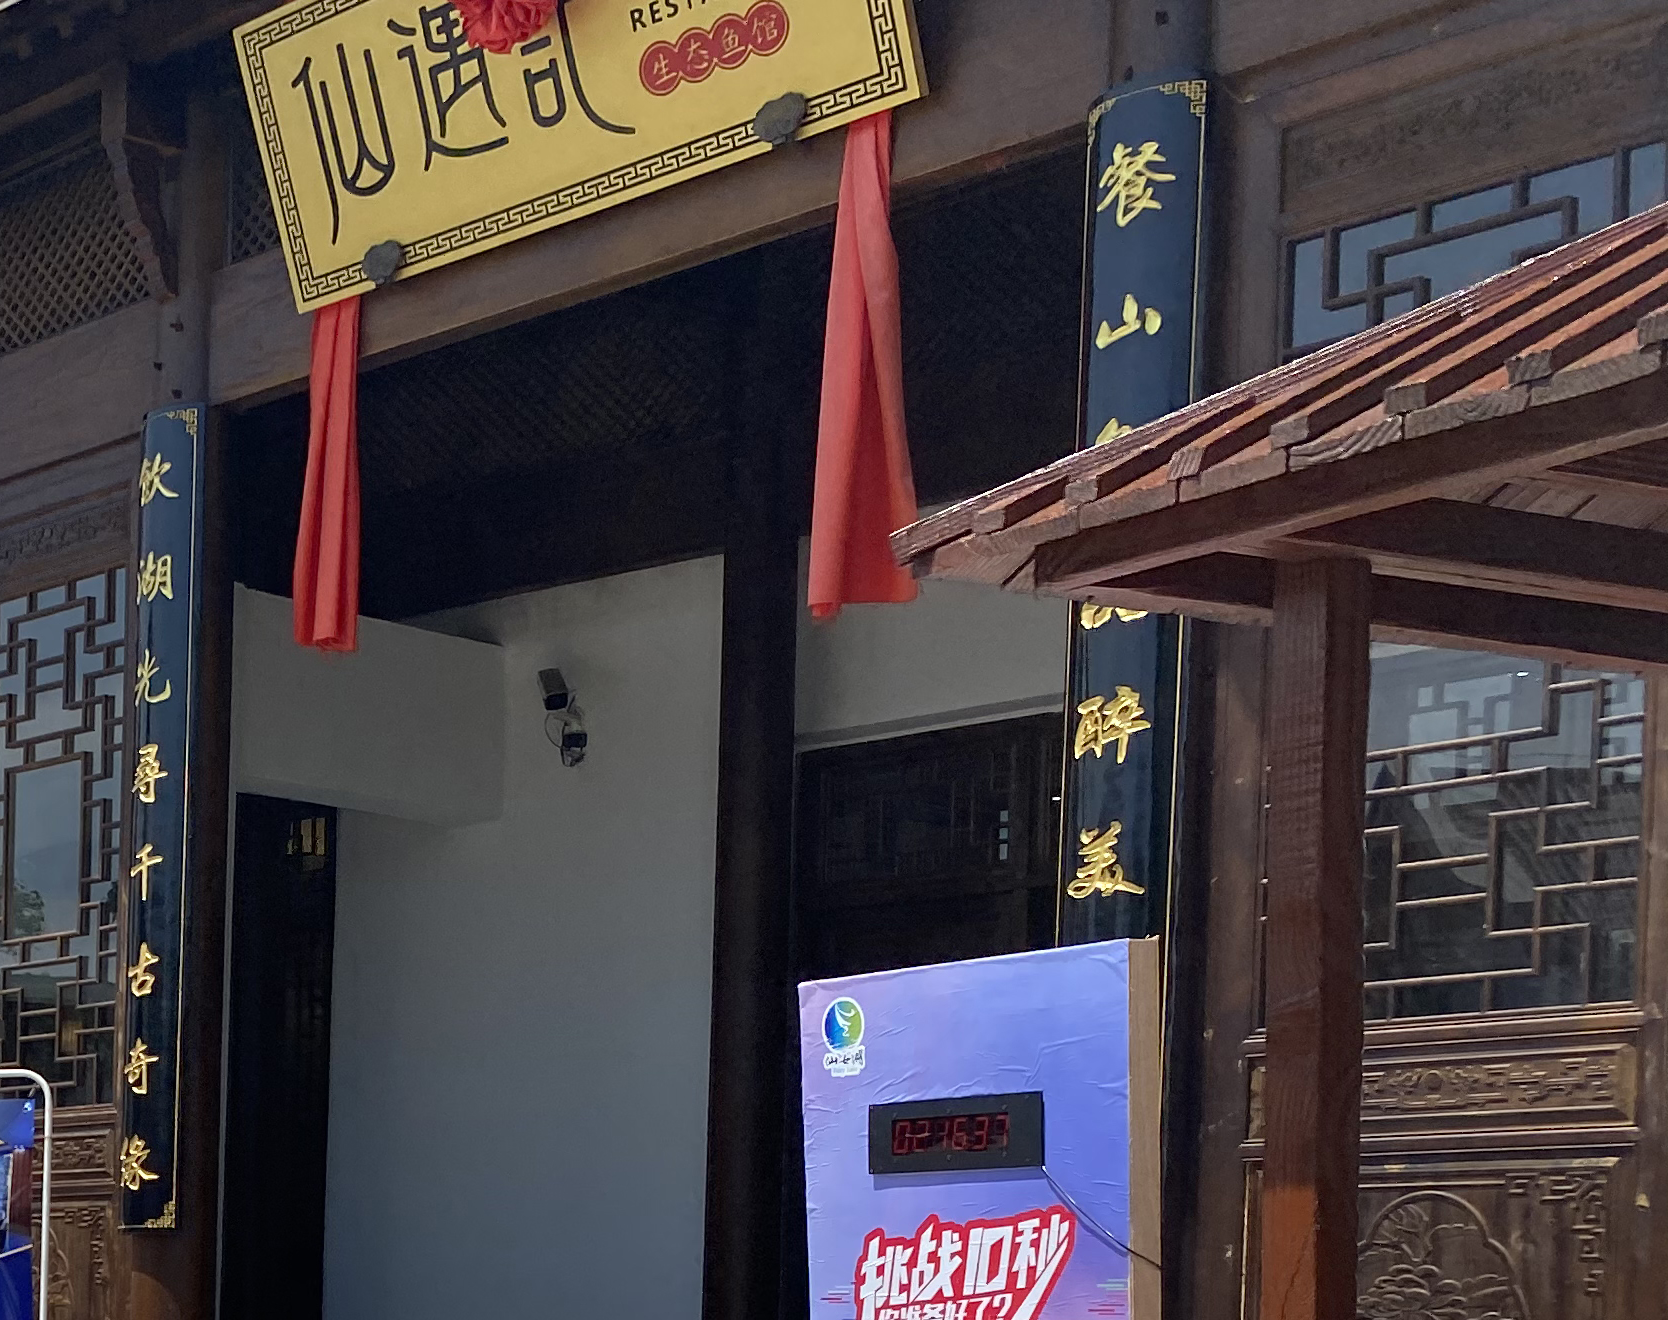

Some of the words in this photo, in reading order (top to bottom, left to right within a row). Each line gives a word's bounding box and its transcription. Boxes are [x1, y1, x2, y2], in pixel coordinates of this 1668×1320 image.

[630, 0, 706, 32] RES
[652, 12, 779, 86] 生态鱼馆
[1065, 141, 1178, 899] 餐山醉美
